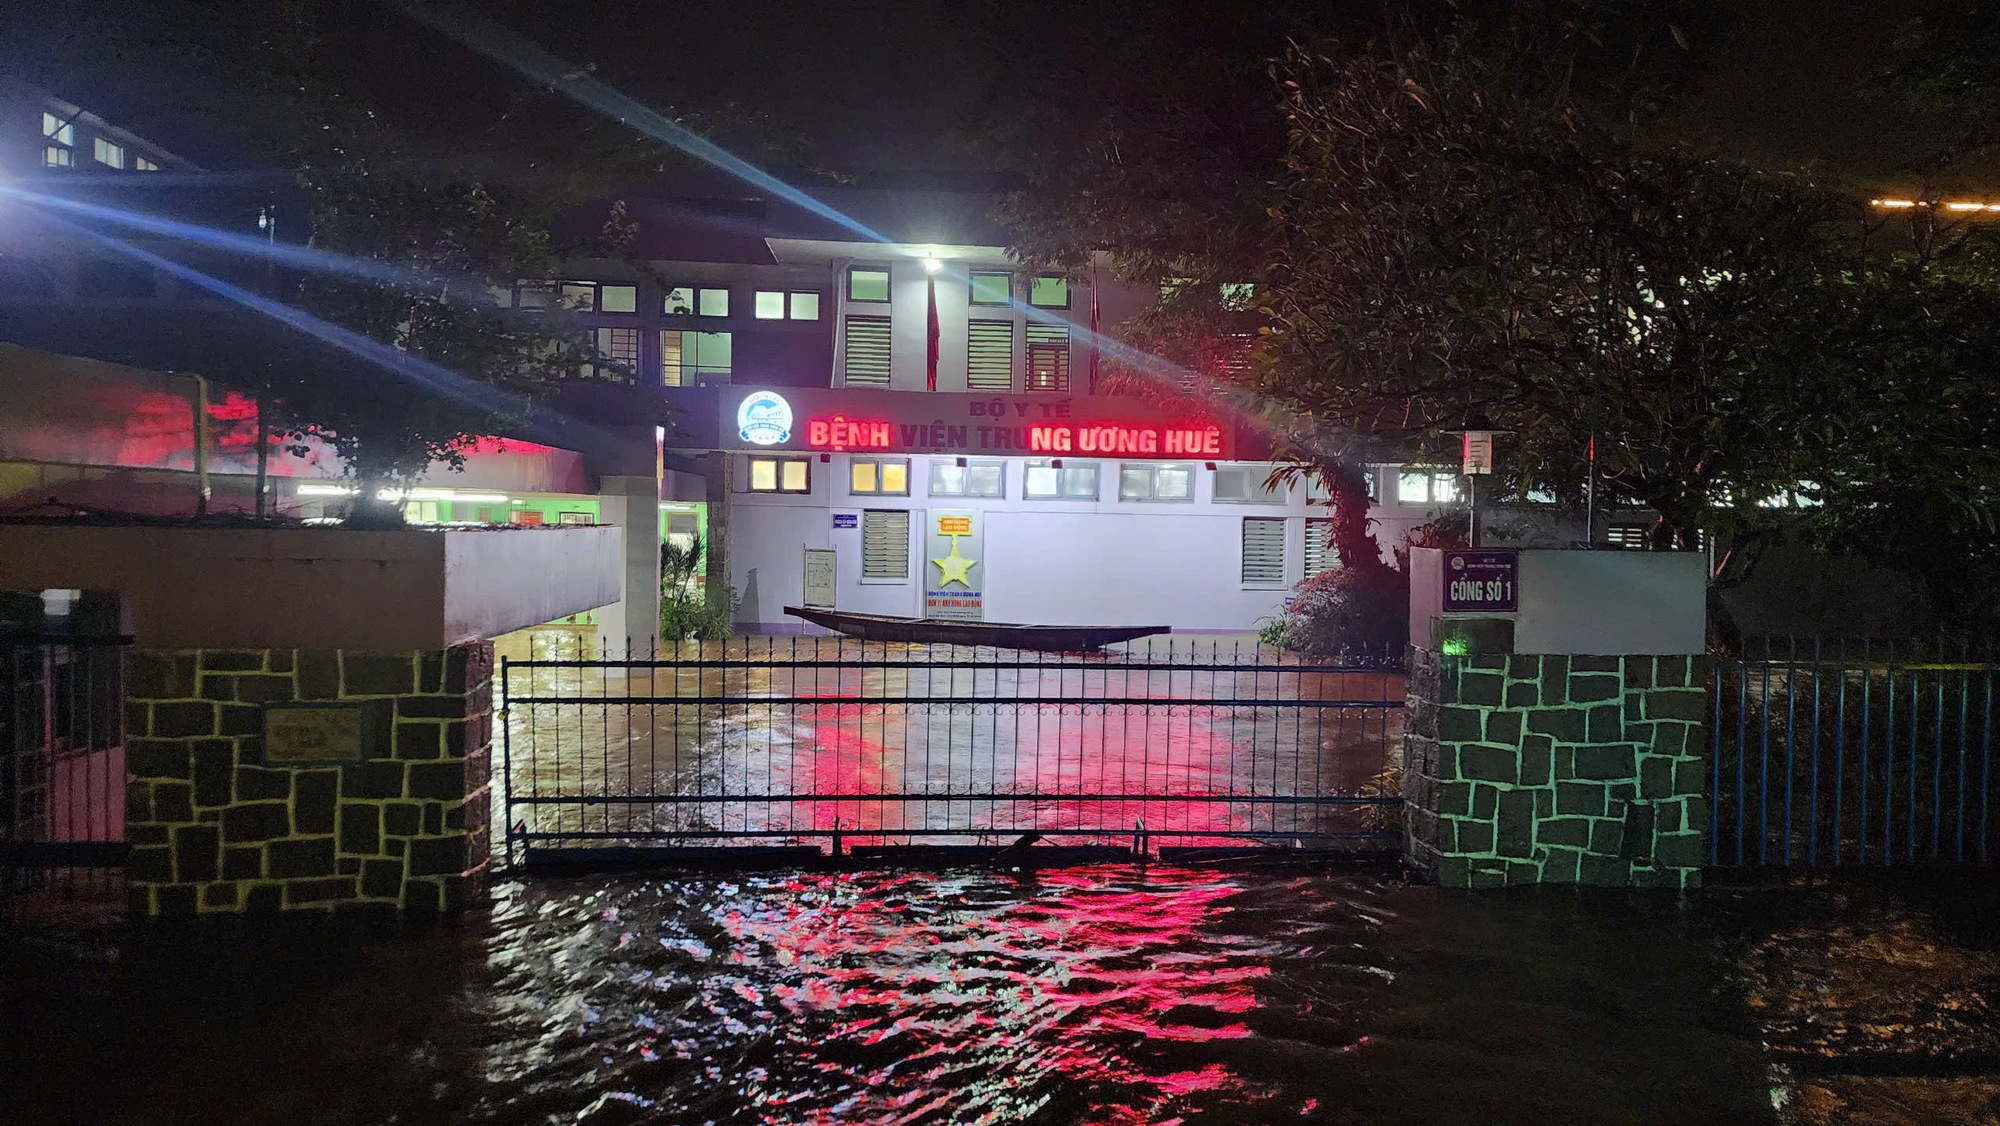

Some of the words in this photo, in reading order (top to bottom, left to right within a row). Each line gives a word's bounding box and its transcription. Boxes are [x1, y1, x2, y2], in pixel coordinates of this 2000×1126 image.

[970, 398, 1006, 421] BỘ
[1014, 402, 1029, 417] Y
[810, 417, 891, 450] BỆNH
[977, 426, 1072, 452] TRUNG
[1079, 426, 1157, 454] ƯƠNG
[1450, 572, 1483, 601] CỔNG
[1486, 573, 1502, 601] SỐ
[1505, 580, 1511, 601] 1
